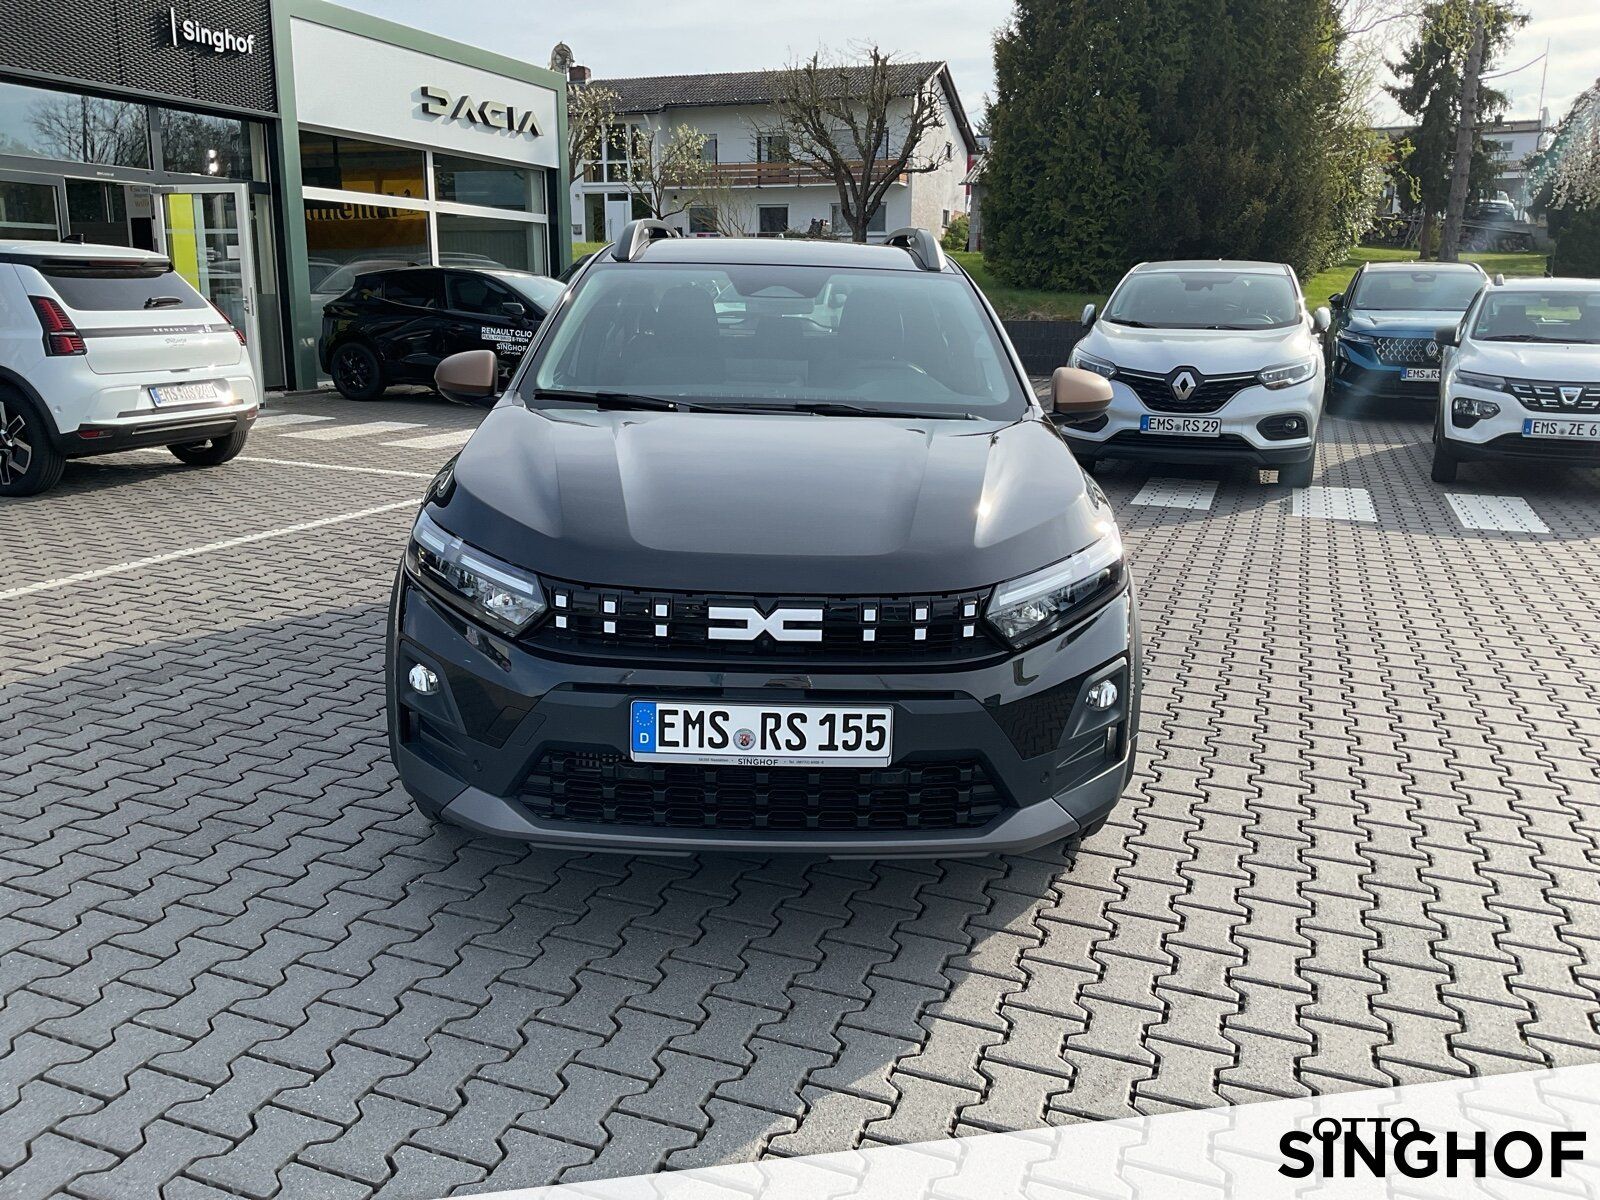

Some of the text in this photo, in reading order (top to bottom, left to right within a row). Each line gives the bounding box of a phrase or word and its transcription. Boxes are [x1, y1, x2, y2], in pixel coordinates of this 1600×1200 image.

[182, 19, 255, 54] Singhof
[420, 85, 544, 137] DACIA
[481, 327, 532, 338] RENAULT CLIO
[496, 344, 526, 352] SINGHOF
[1406, 369, 1425, 379] EMS
[1148, 418, 1174, 431] EMS
[1182, 419, 1200, 432] RS
[1202, 420, 1219, 433] 29
[1532, 421, 1557, 434] EMS
[1568, 423, 1585, 436] ZE
[639, 709, 887, 751] D EMS RS 155
[737, 756, 779, 766] SINGHOF
